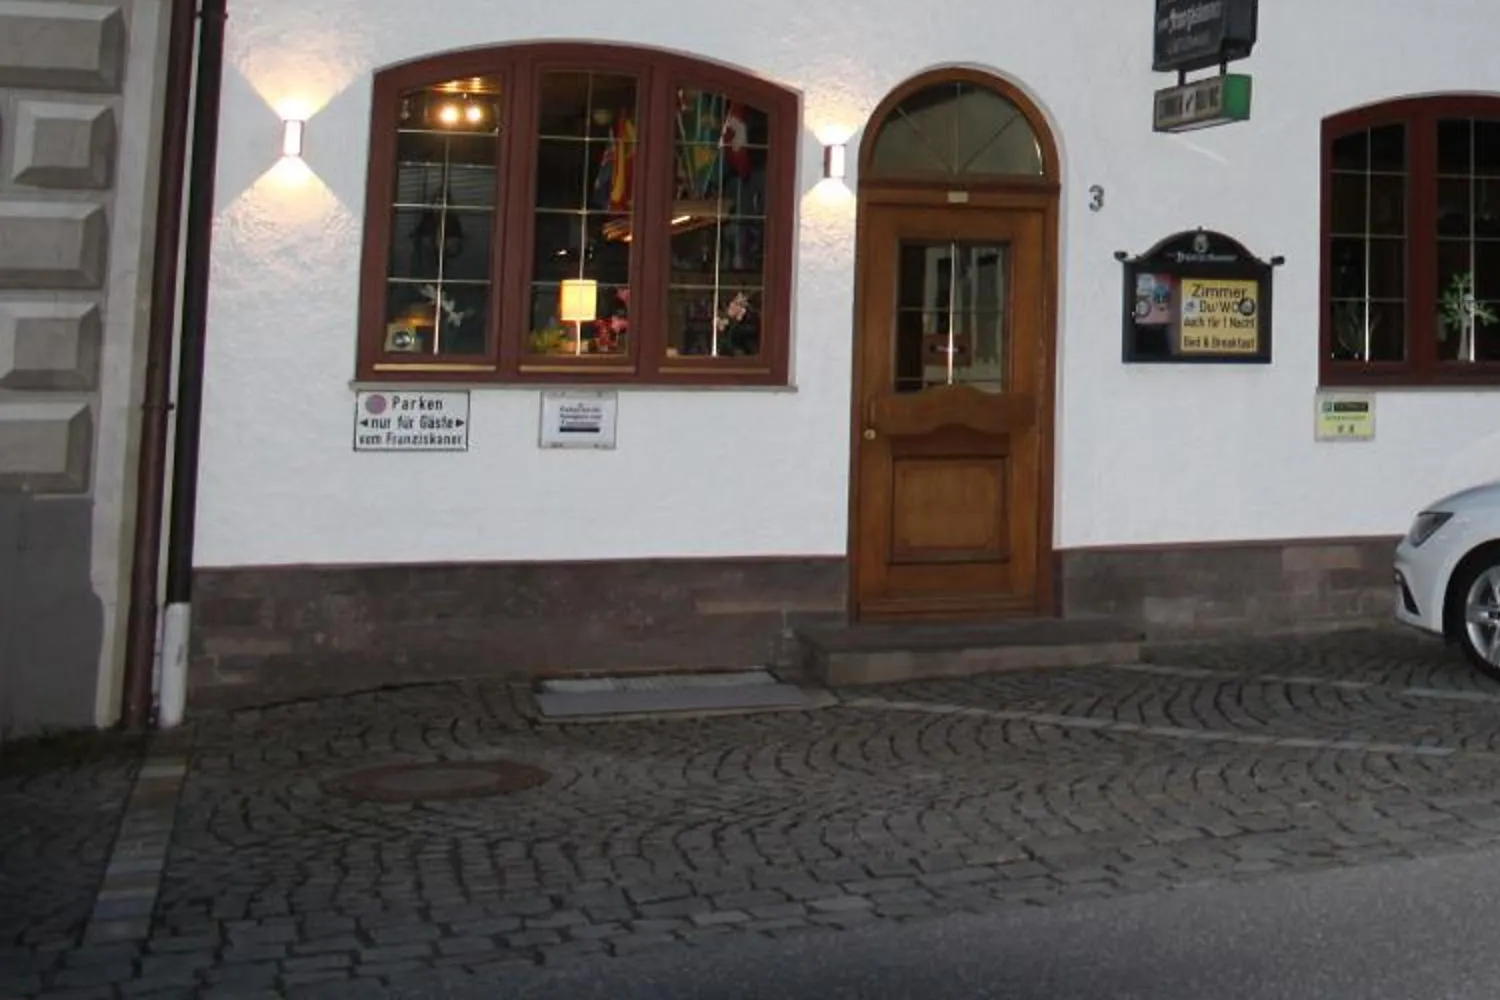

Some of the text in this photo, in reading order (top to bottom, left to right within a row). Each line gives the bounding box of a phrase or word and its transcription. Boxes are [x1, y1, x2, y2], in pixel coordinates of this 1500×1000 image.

[1089, 184, 1104, 212] 3
[1191, 283, 1247, 298] Zimmer
[392, 396, 443, 411] Parken
[371, 418, 391, 429] nur
[398, 416, 414, 429] für
[386, 432, 462, 445] Franziskaner
